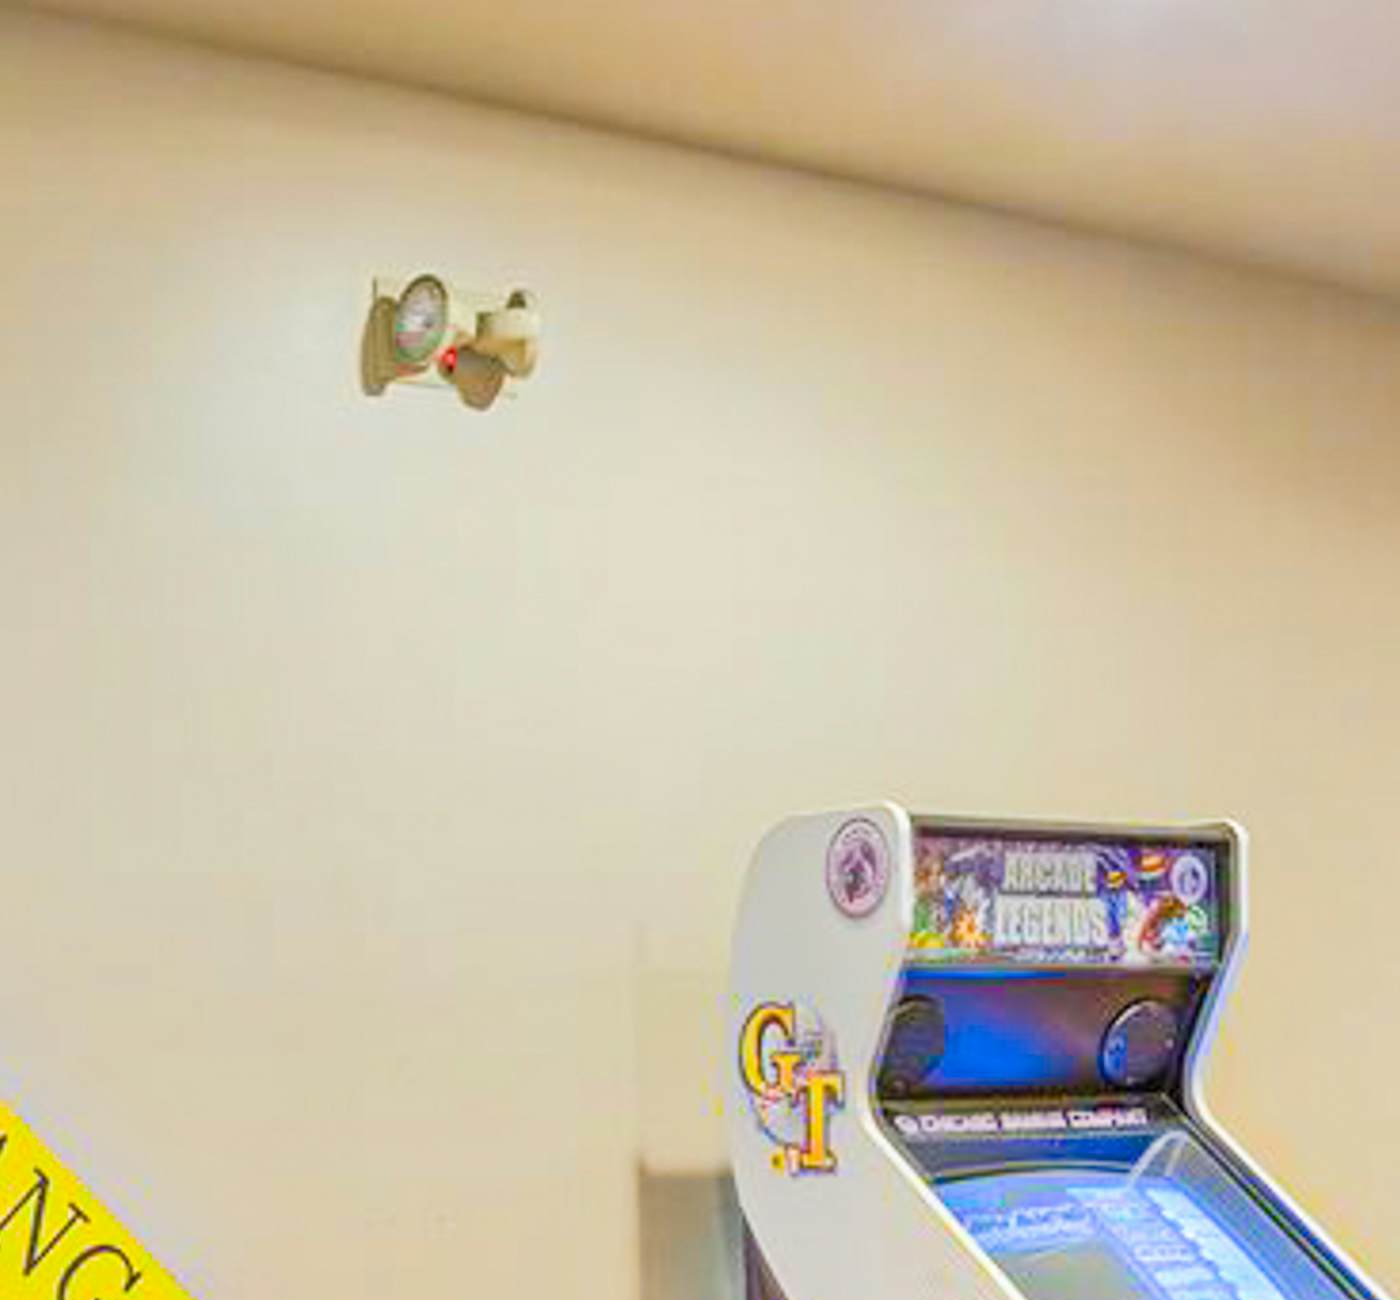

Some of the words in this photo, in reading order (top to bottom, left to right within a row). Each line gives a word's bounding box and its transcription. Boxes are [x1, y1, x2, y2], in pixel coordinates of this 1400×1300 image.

[1003, 851, 1098, 892] ARCADE
[996, 897, 1108, 946] LEGENDS
[921, 1113, 998, 1134] CHICAGO
[1068, 1108, 1148, 1130] COMPANY
